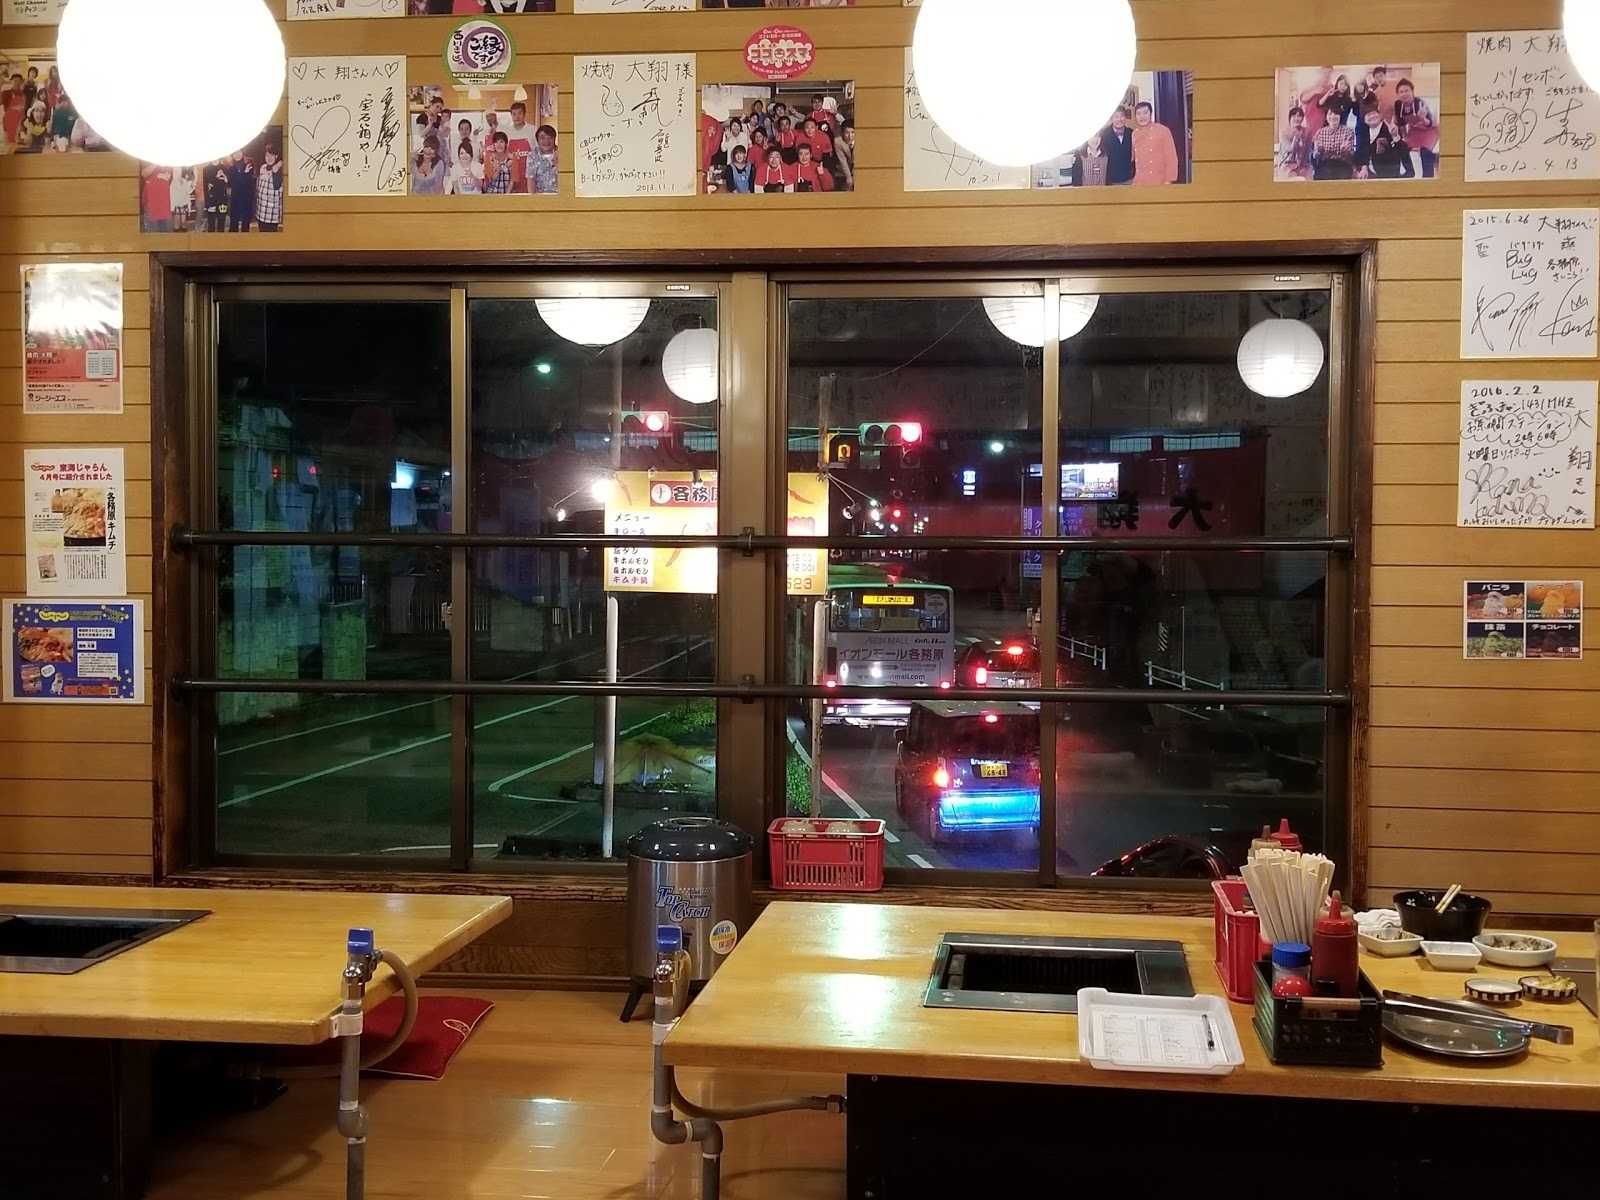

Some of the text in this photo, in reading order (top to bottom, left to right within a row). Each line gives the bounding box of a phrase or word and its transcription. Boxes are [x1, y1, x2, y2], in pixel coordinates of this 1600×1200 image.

[581, 60, 615, 80] 焼肉
[674, 62, 694, 81] 様
[673, 486, 717, 502] 各務
[1482, 583, 1511, 591] バニラ
[839, 647, 945, 661] イオンモール各務原
